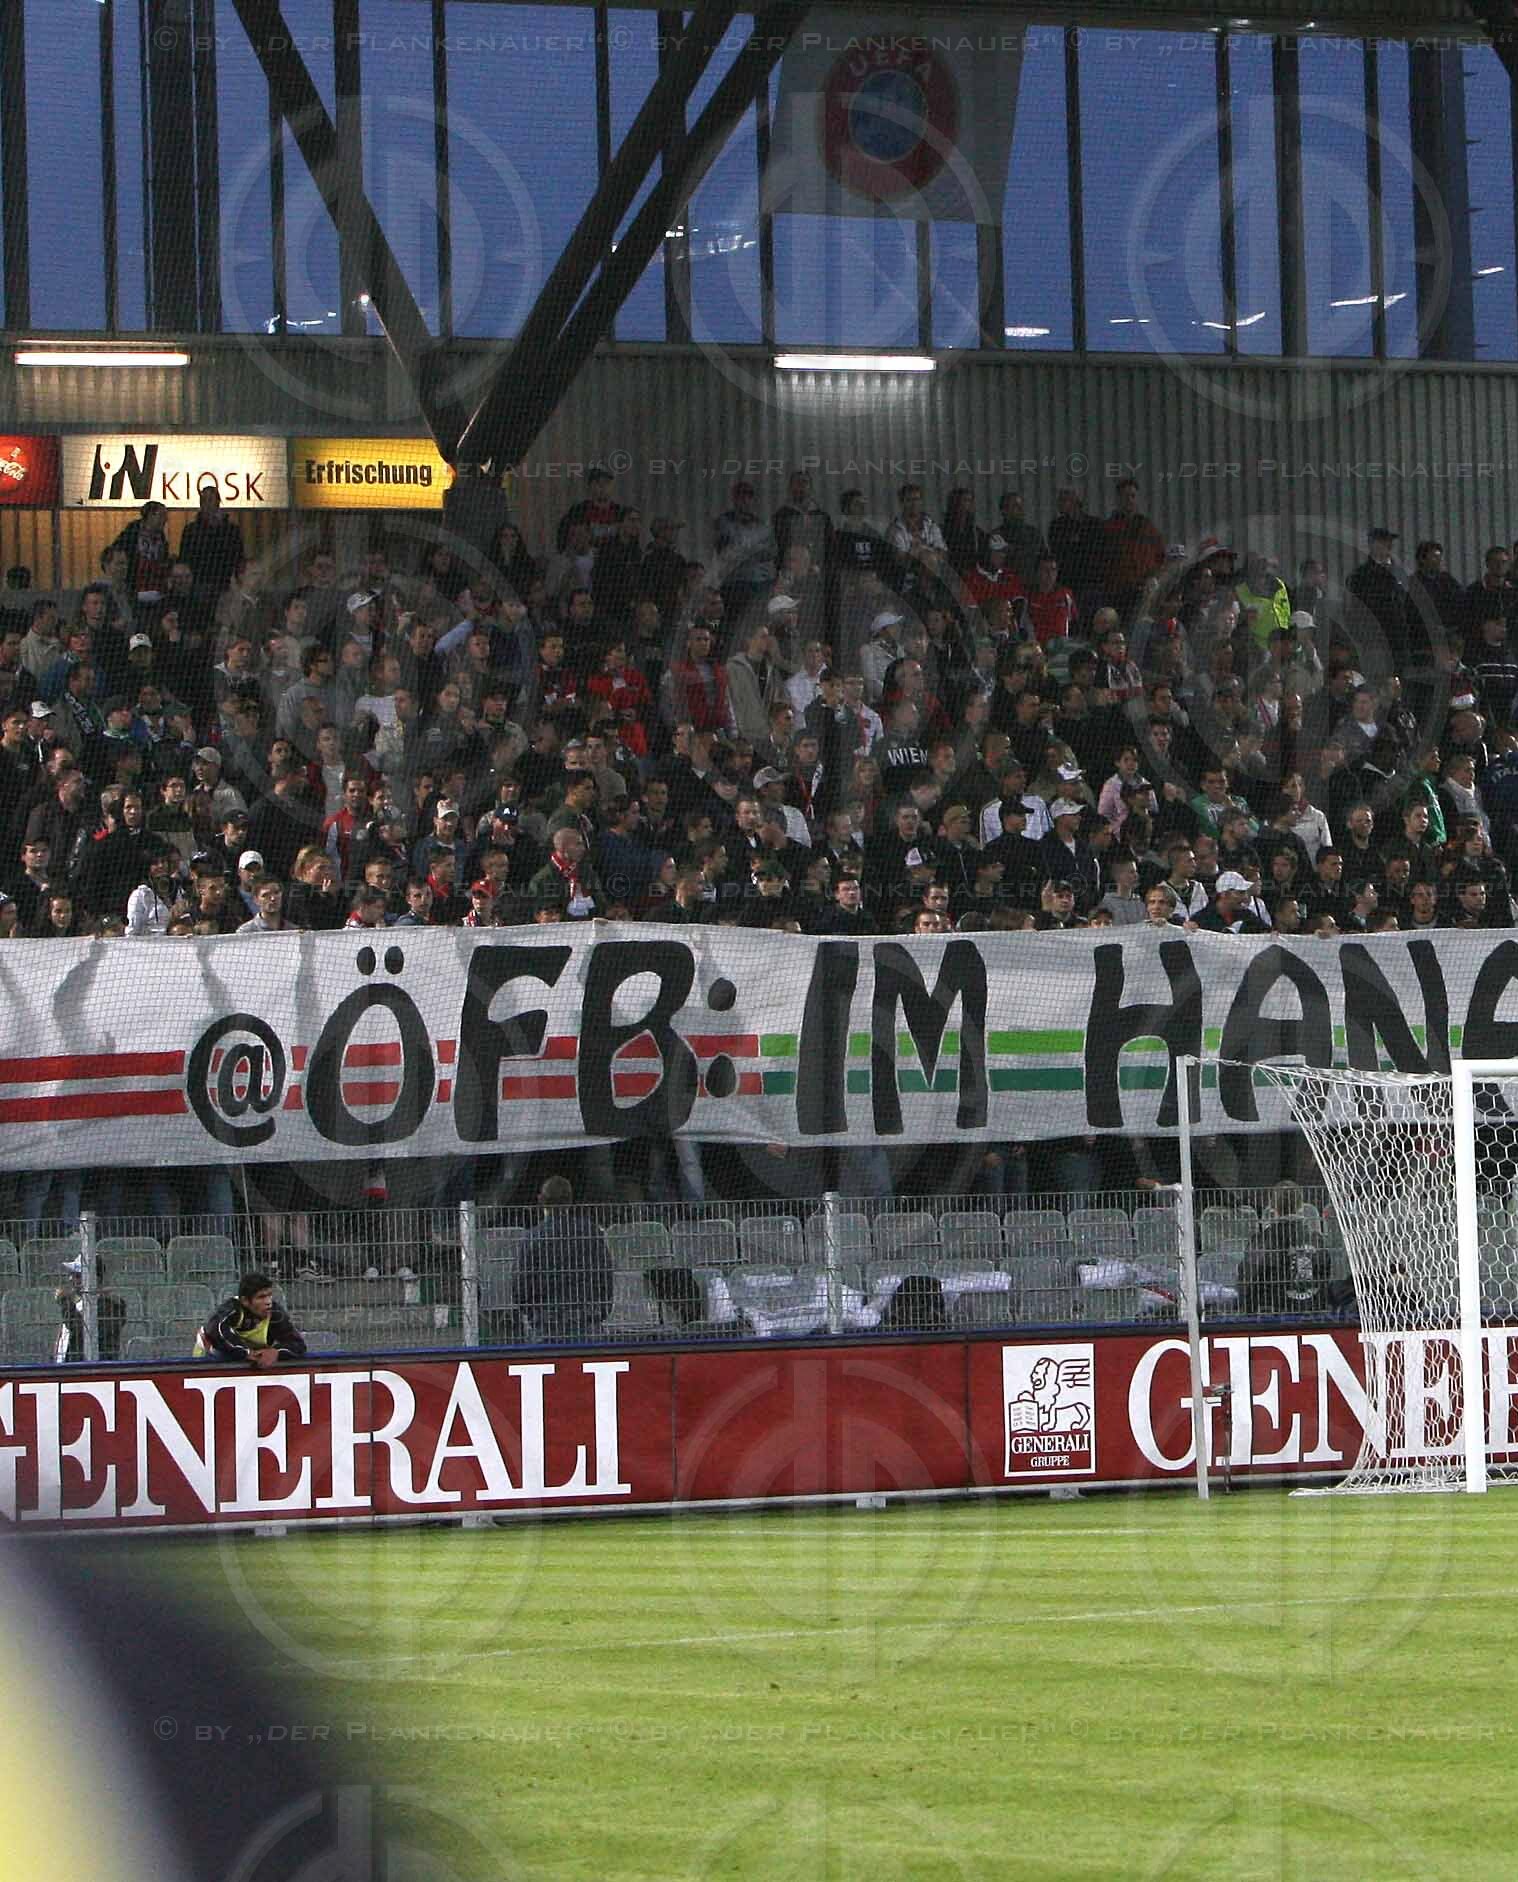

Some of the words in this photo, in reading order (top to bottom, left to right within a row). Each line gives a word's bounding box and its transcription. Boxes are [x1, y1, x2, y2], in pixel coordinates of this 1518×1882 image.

[850, 50, 931, 80] UEFA
[162, 471, 264, 501] KIOSK
[305, 460, 433, 487] Erfrischung
[888, 747, 928, 766] WIEN
[796, 940, 988, 1135] IM
[0, 1361, 631, 1521] ENERALI
[1011, 1433, 1089, 1454] GENERALI
[1030, 1455, 1070, 1467] GRUPPE
